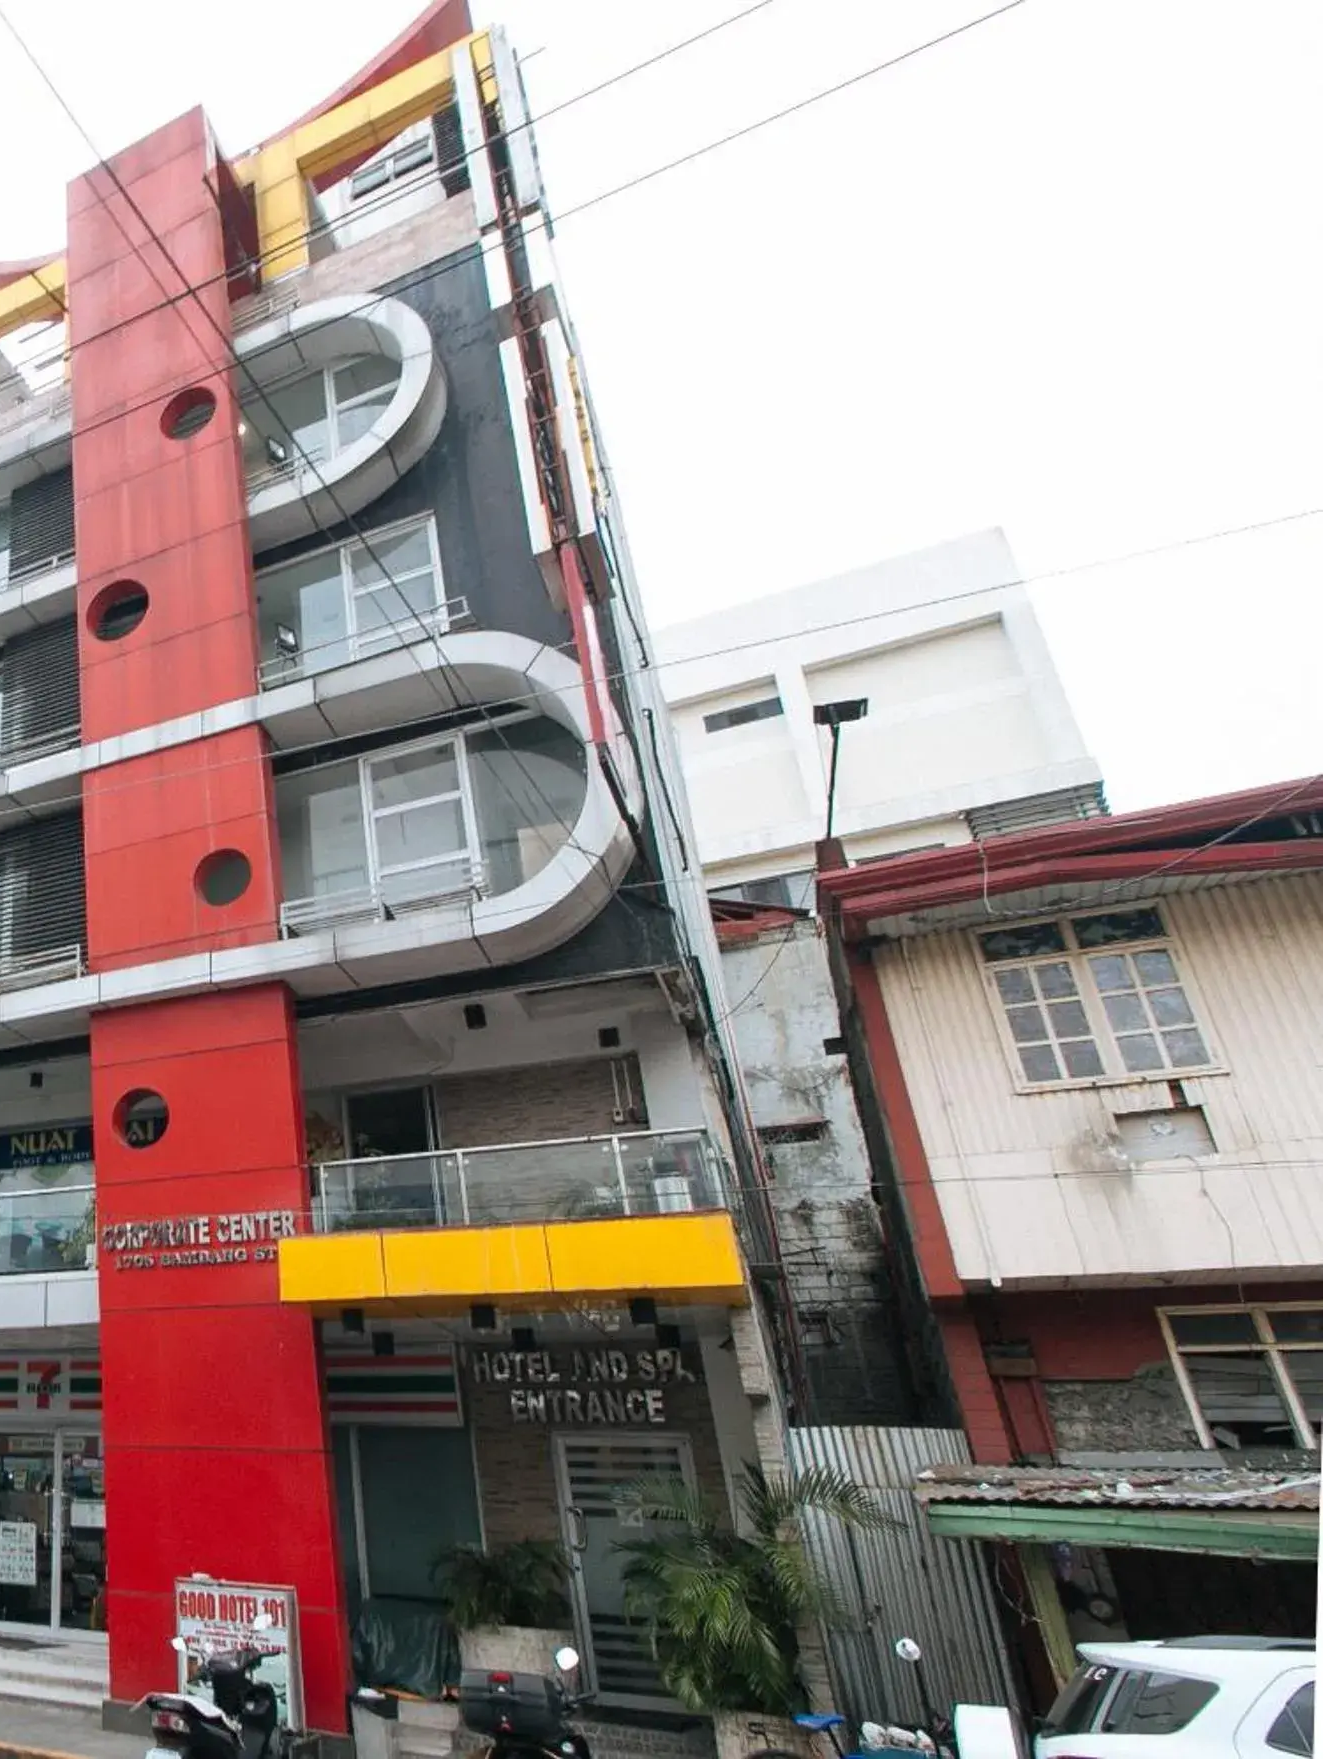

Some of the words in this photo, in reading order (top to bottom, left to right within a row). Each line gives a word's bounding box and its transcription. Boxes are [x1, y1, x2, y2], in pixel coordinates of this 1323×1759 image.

[216, 1211, 296, 1243] CENTER
[475, 1352, 560, 1382] HOTEL
[511, 1388, 665, 1423] ENTRANCE
[179, 1590, 216, 1620] GOOD
[218, 1593, 258, 1624] HOTEL
